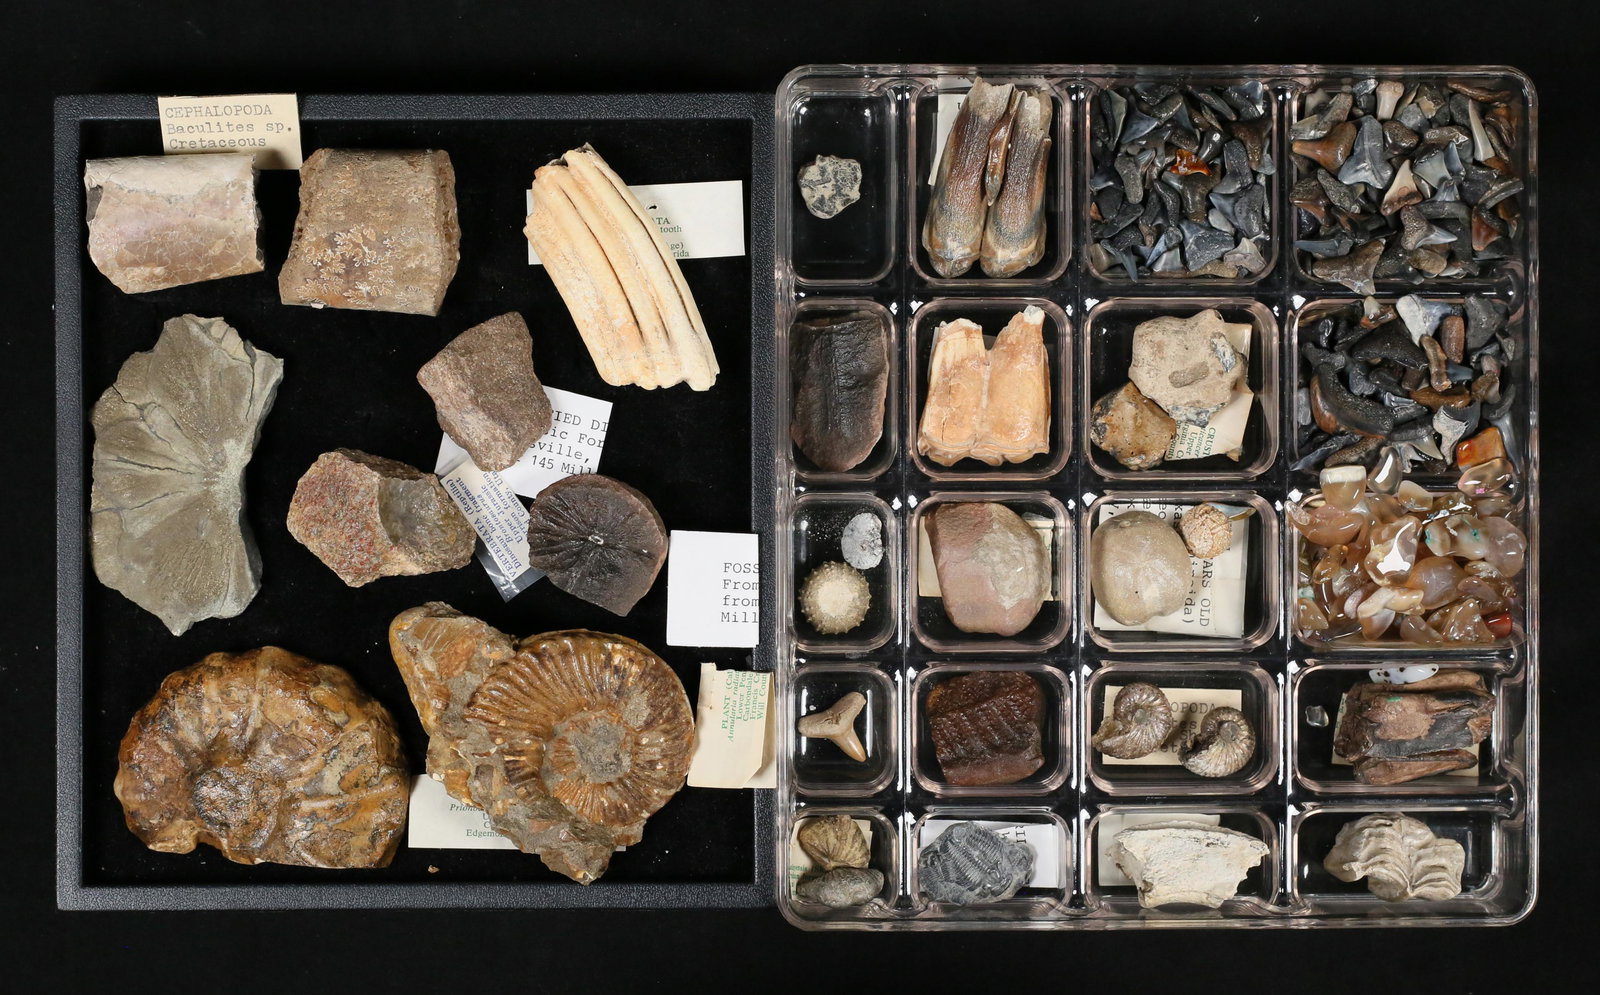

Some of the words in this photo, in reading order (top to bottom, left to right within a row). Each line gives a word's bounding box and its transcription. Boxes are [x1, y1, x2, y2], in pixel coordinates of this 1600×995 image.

[165, 104, 272, 118] CEPHALOPODA
[167, 122, 254, 134] Baculites
[266, 122, 291, 133] sp.
[169, 138, 267, 150] Cretaceous
[652, 217, 670, 225] TA
[660, 225, 682, 233] tooth
[551, 409, 581, 426] IED
[1186, 432, 1198, 455] Upper
[532, 455, 554, 469] 145
[445, 477, 474, 515] (Reptilia)
[455, 476, 482, 512] fragment
[480, 484, 504, 516] Jurassic
[481, 472, 509, 510] formation
[502, 487, 525, 517] County,
[476, 493, 512, 543] Brontosaurus
[480, 514, 496, 533] bone
[503, 517, 523, 543] Upper
[509, 511, 528, 537] rrison
[473, 517, 517, 577] VERTEBRATA
[494, 533, 521, 569] Dinosaur
[723, 563, 759, 573] FOSS
[1202, 558, 1213, 588] ARS
[723, 579, 759, 590] From
[723, 595, 759, 606] from
[1200, 598, 1211, 627] OLD
[721, 612, 759, 623] Mill
[736, 693, 744, 720] Lower
[743, 673, 753, 722] Carbondale
[750, 688, 758, 720] Francis
[722, 696, 731, 729] PLANT
[728, 700, 737, 742] Annularia
[757, 702, 765, 720] Will
